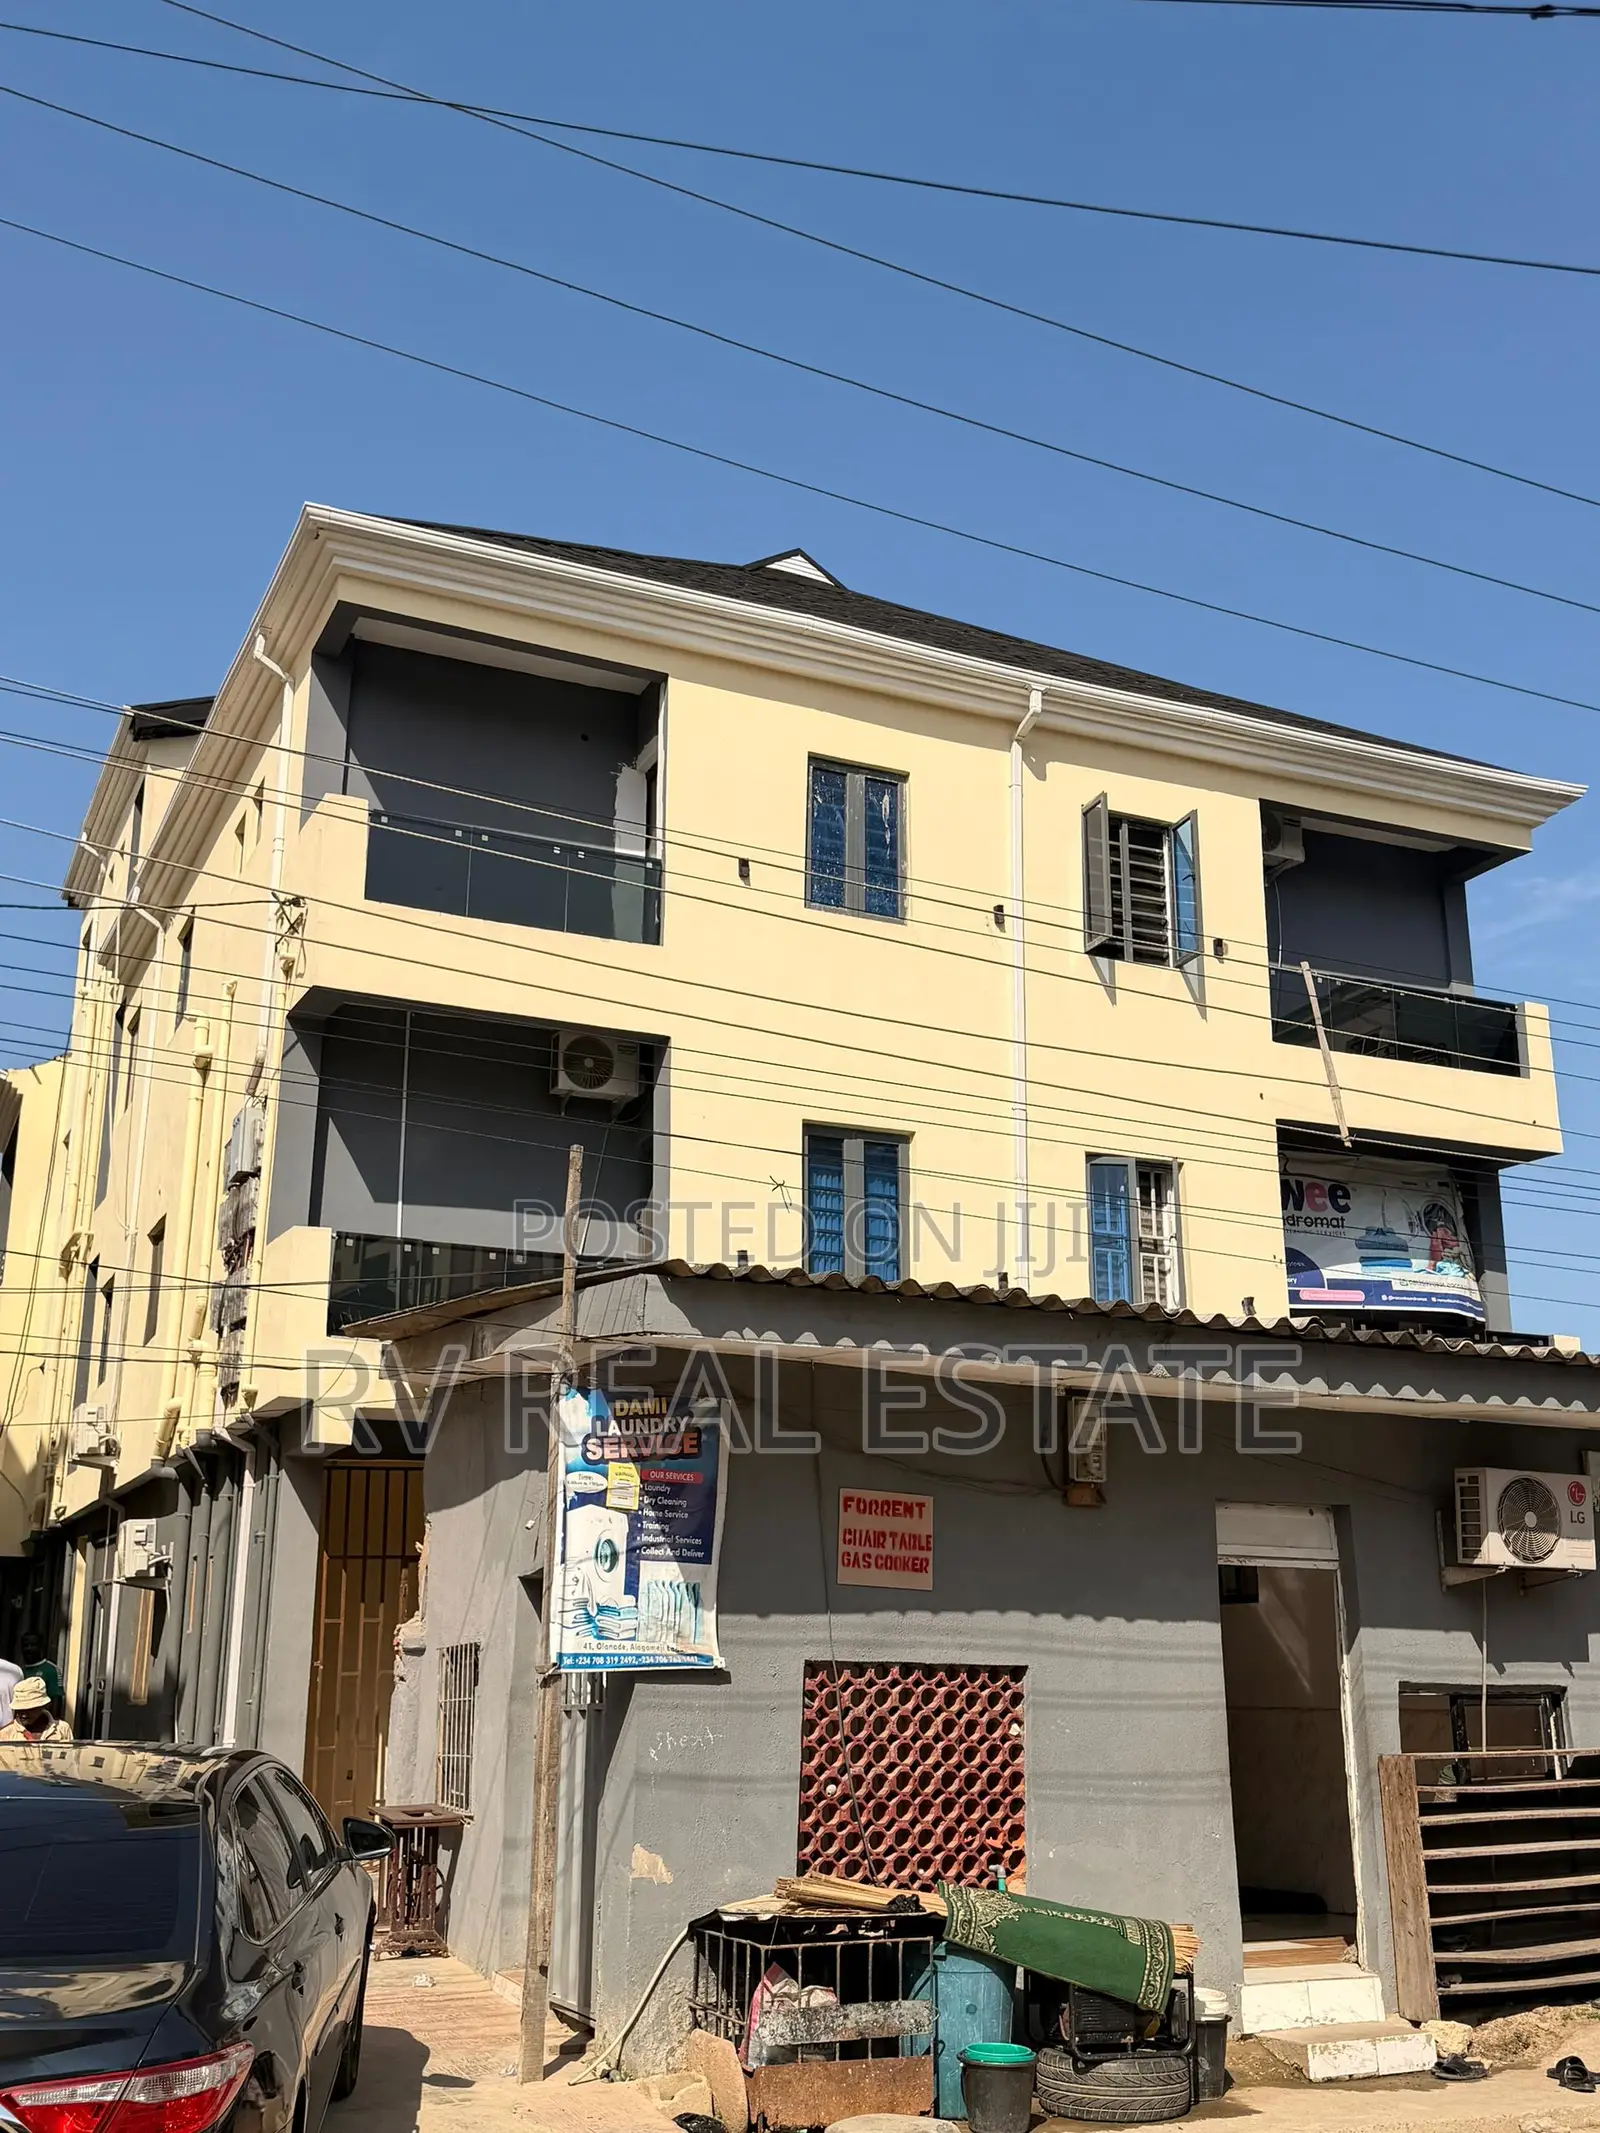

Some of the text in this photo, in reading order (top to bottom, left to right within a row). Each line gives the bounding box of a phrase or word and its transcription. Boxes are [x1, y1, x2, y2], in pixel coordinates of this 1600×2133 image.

[615, 1397, 668, 1416] DAMI
[596, 1415, 689, 1436] LAUNDRY
[586, 1432, 698, 1460] SERVICE
[650, 1470, 694, 1481] OUR SERVICES
[644, 1483, 671, 1494] Laundry
[643, 1496, 687, 1508] Dry Cleaning
[643, 1508, 689, 1519] Home Service
[1570, 1510, 1585, 1524] LG
[642, 1521, 670, 1532] Training
[641, 1533, 702, 1545] Industrial Services
[842, 1528, 932, 1552] CHAIR TABLE
[641, 1546, 705, 1558] Collect And Deliver
[841, 1551, 930, 1574] GAS COOKER
